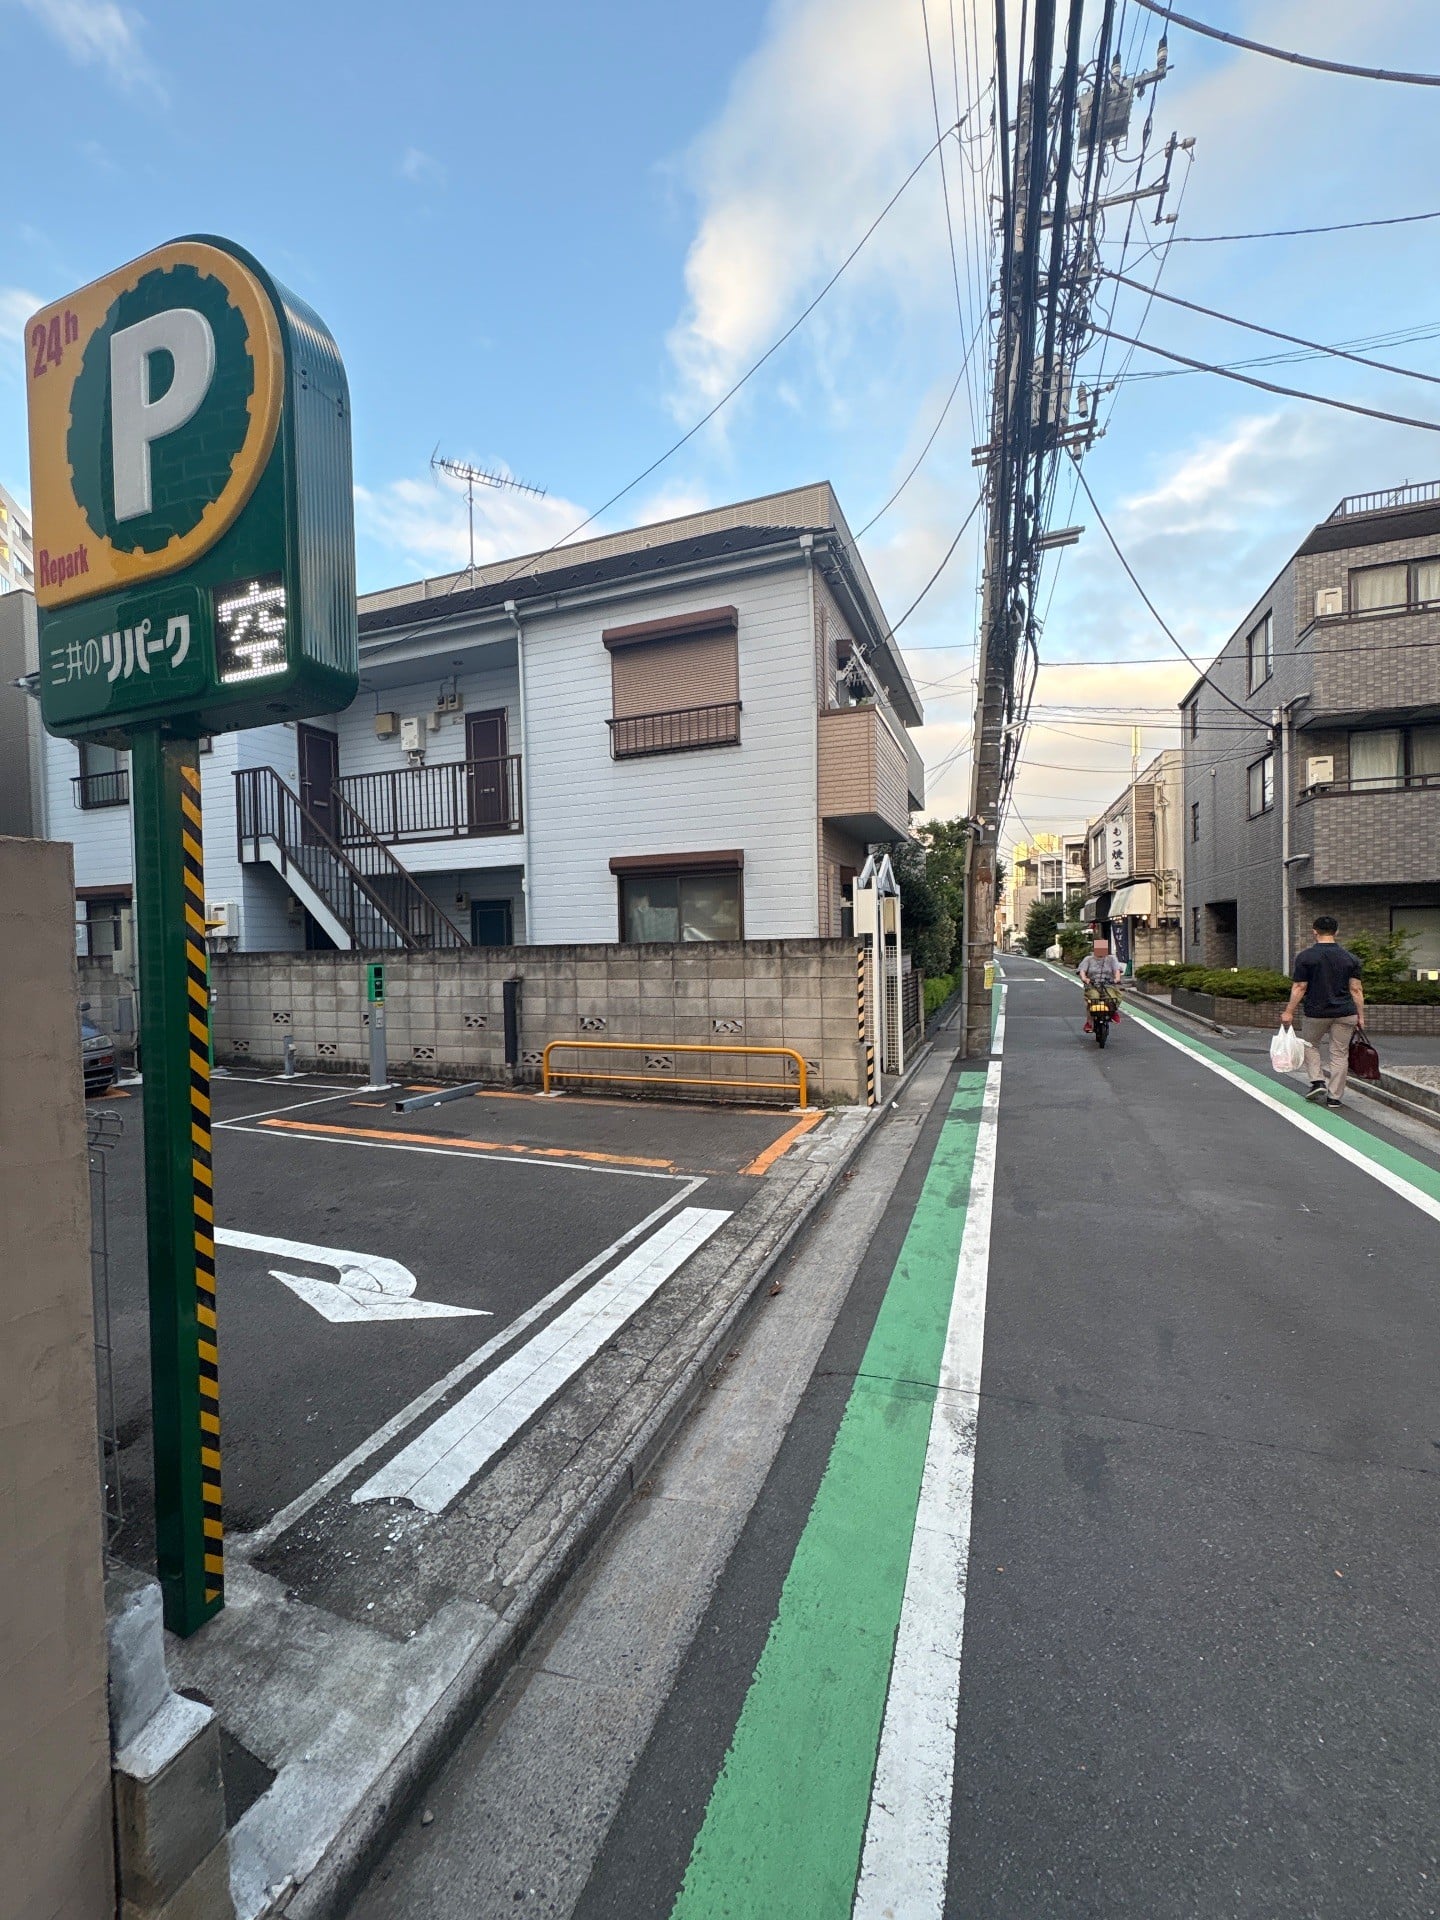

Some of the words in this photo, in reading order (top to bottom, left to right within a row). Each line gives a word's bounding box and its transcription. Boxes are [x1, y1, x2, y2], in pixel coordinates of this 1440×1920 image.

[32, 309, 78, 378] 24h
[110, 308, 215, 522] P
[39, 544, 89, 587] Repark
[51, 614, 190, 685] 三井のリパーク
[218, 581, 288, 682] 空
[1111, 827, 1124, 870] もつ焼き
